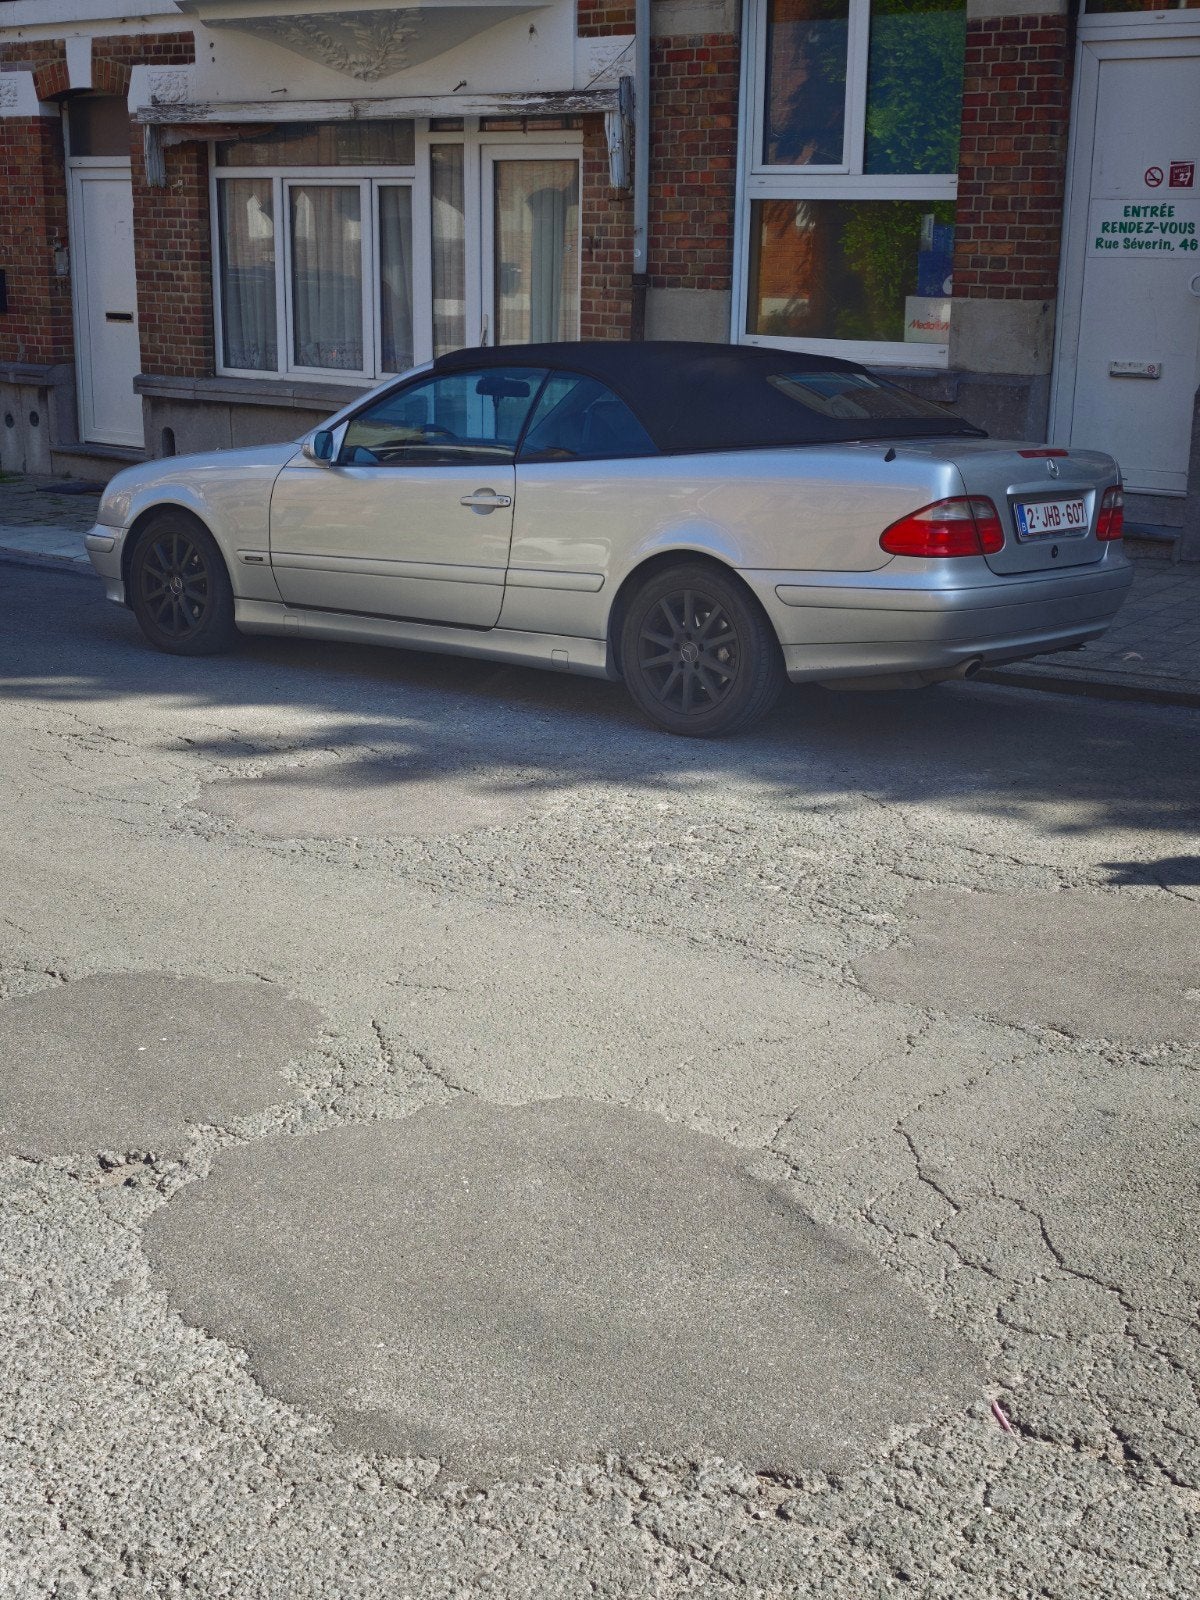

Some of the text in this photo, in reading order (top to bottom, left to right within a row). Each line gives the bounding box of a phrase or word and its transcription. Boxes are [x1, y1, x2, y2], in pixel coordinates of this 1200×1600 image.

[1123, 202, 1176, 218] ENTRÉE
[1101, 221, 1196, 235] RENDEZ-VOUS
[1095, 237, 1199, 252] Rue Séverin, 46
